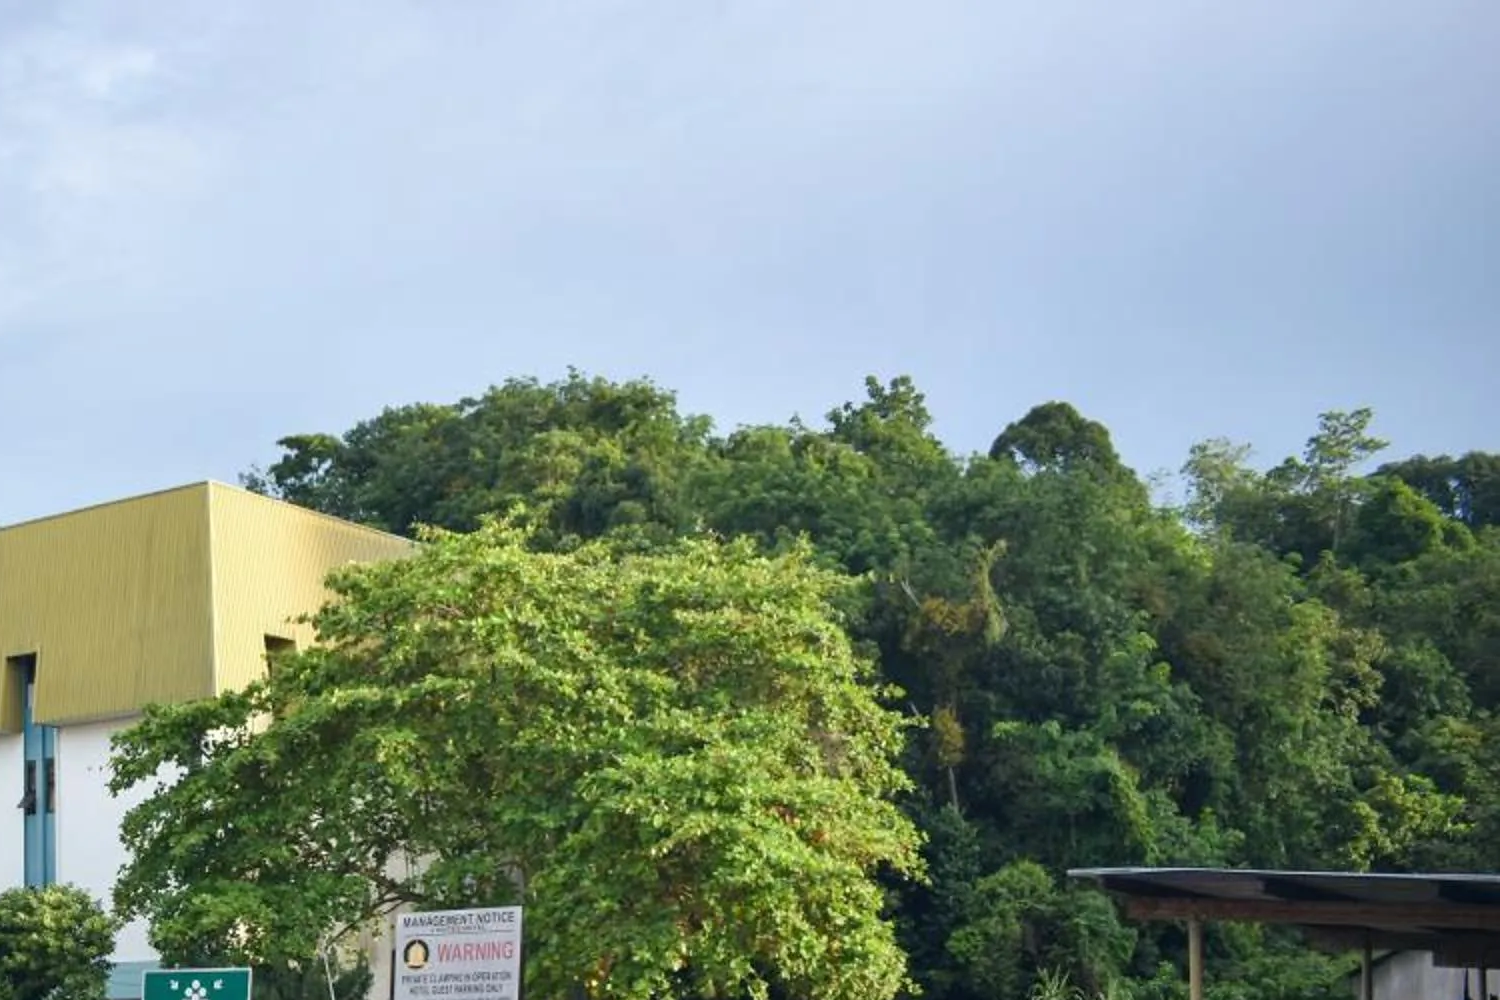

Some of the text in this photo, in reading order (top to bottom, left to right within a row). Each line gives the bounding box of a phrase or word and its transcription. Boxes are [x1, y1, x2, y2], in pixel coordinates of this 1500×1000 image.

[403, 911, 516, 928] MANAGEMENT NOTICE
[437, 941, 514, 963] WARNING
